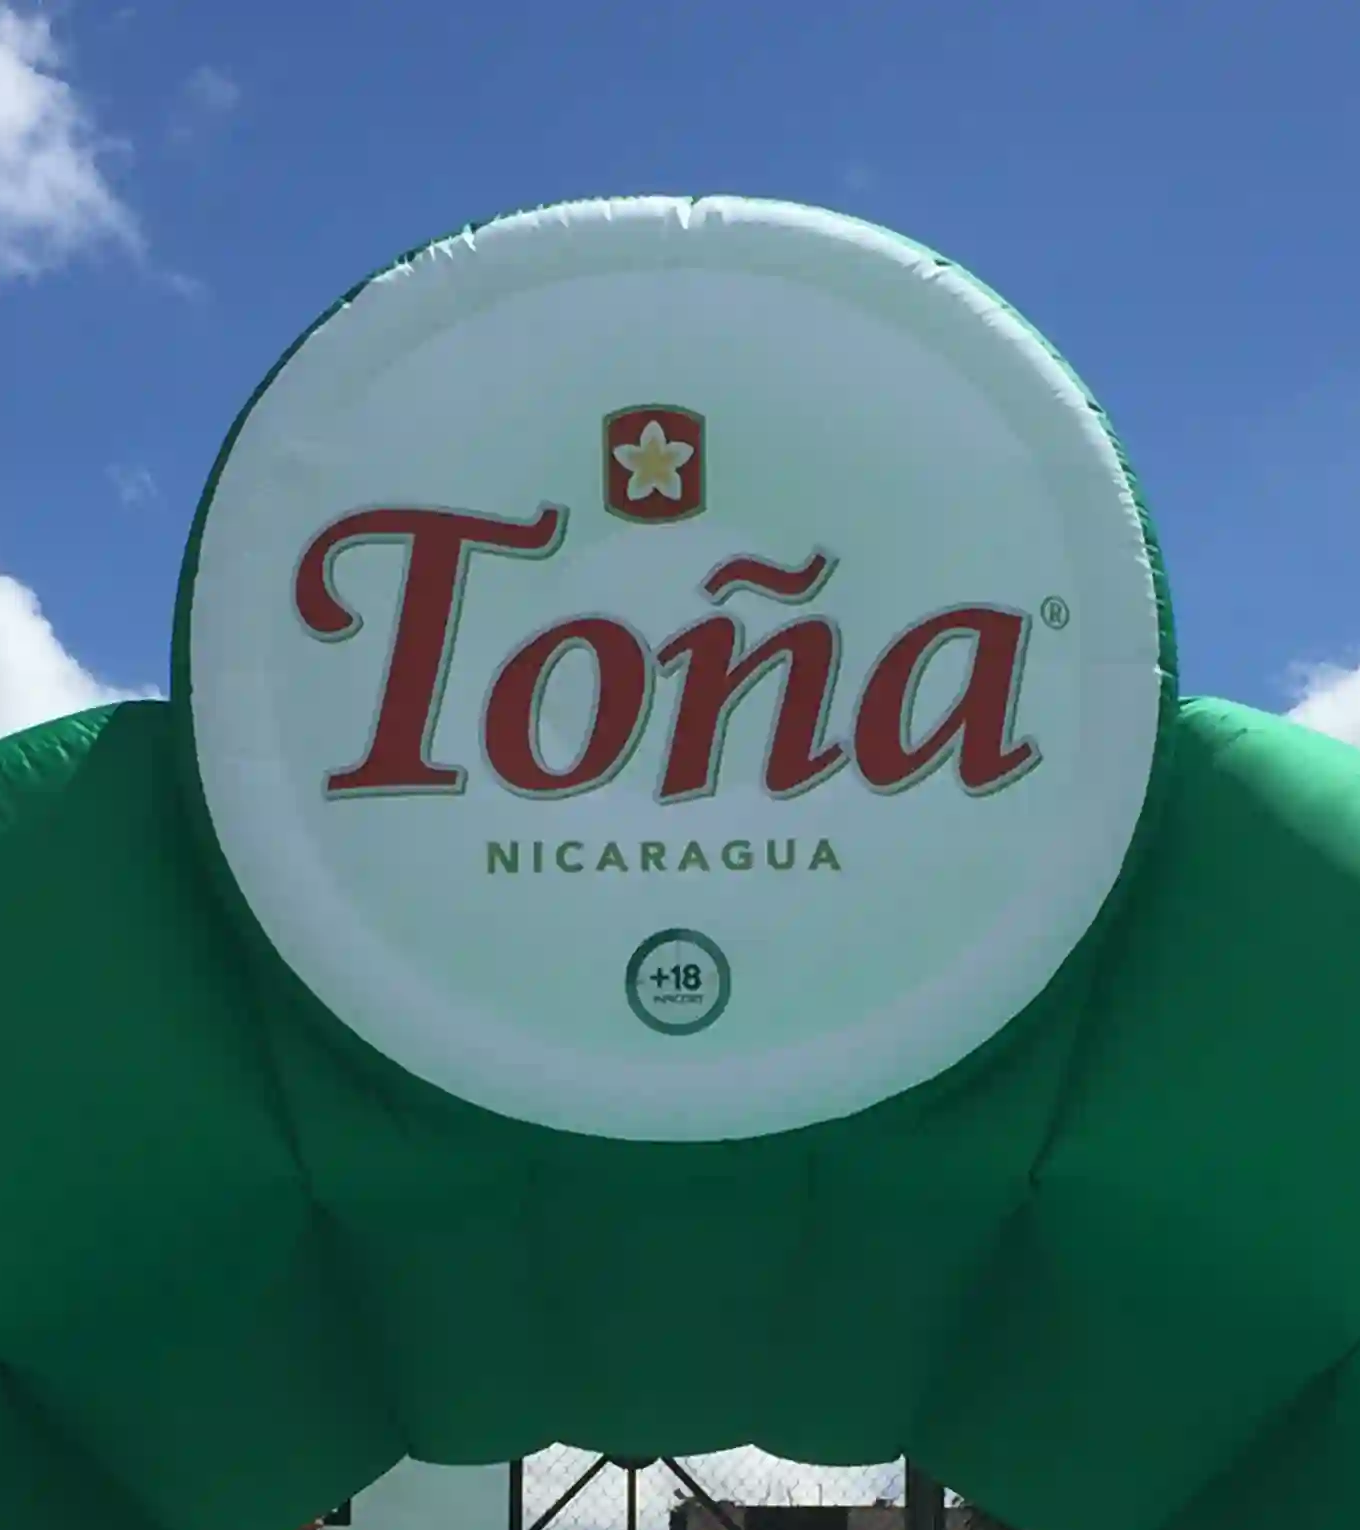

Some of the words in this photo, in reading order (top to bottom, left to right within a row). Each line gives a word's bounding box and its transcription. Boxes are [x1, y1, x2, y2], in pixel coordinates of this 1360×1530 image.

[294, 502, 1042, 803] Toña
[486, 838, 842, 875] NICARAGUA
[650, 964, 702, 991] +18
